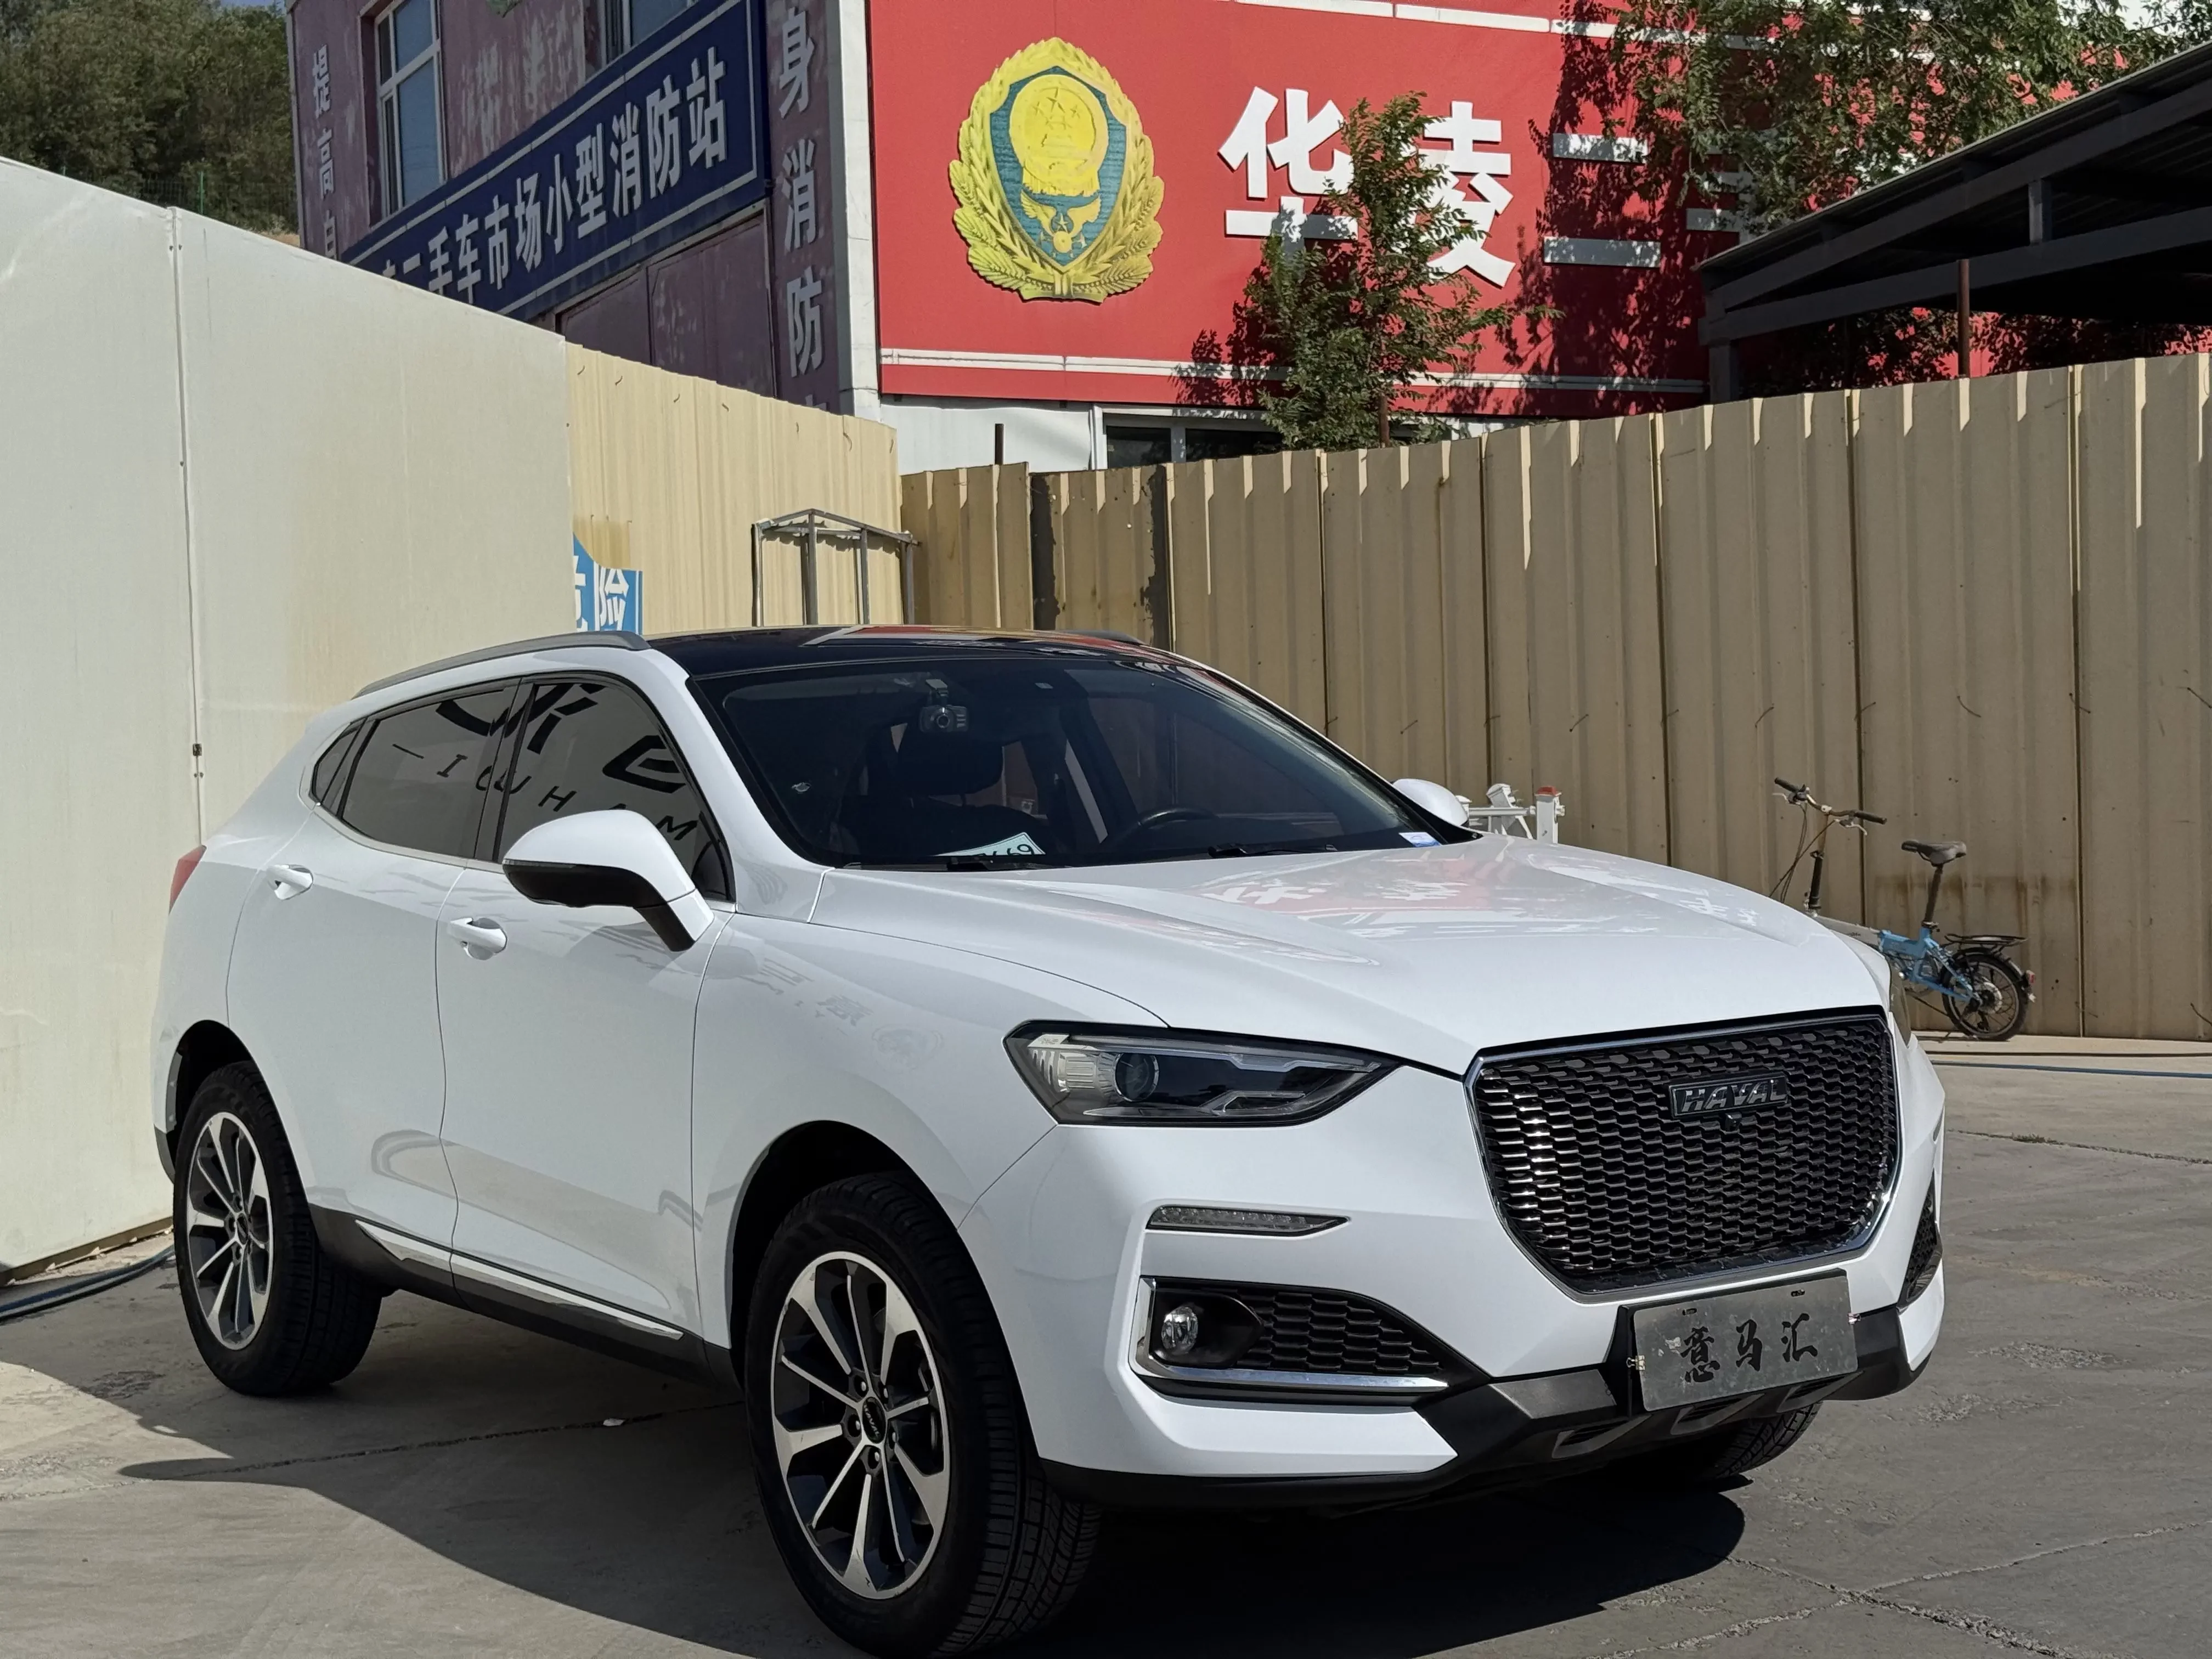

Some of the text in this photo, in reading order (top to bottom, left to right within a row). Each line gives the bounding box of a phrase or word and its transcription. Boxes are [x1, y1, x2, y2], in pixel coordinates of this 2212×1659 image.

[382, 46, 726, 304] 二手车市场小型消防站
[778, 7, 827, 409] 身消防
[1681, 1079, 1787, 1112] HAVAL
[1680, 1313, 1818, 1383] 意马汇
